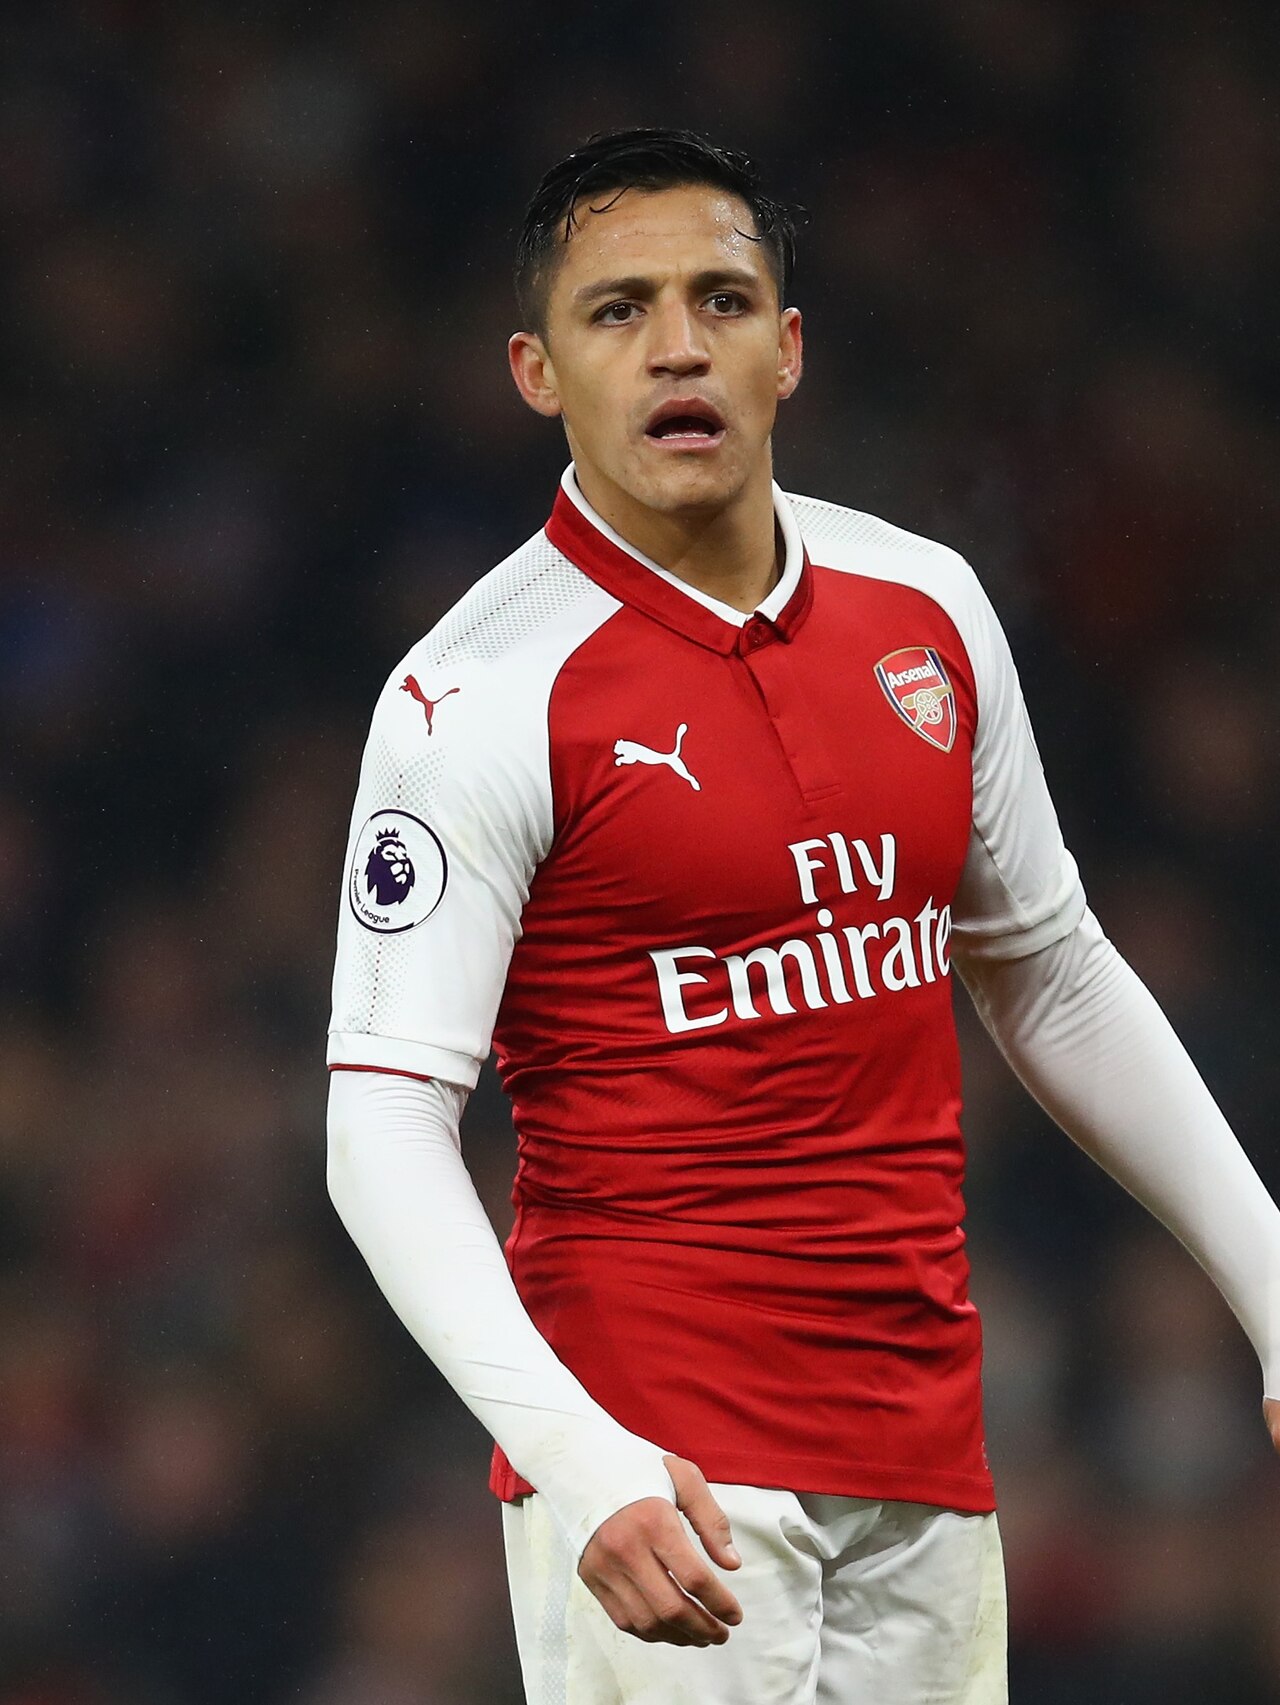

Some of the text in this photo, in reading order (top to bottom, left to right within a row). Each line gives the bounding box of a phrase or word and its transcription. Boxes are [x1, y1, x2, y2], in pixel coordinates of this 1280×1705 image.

[887, 660, 937, 688] Arsenal
[787, 831, 897, 905] Fly
[360, 903, 390, 924] League
[648, 895, 952, 1034] Emirate
